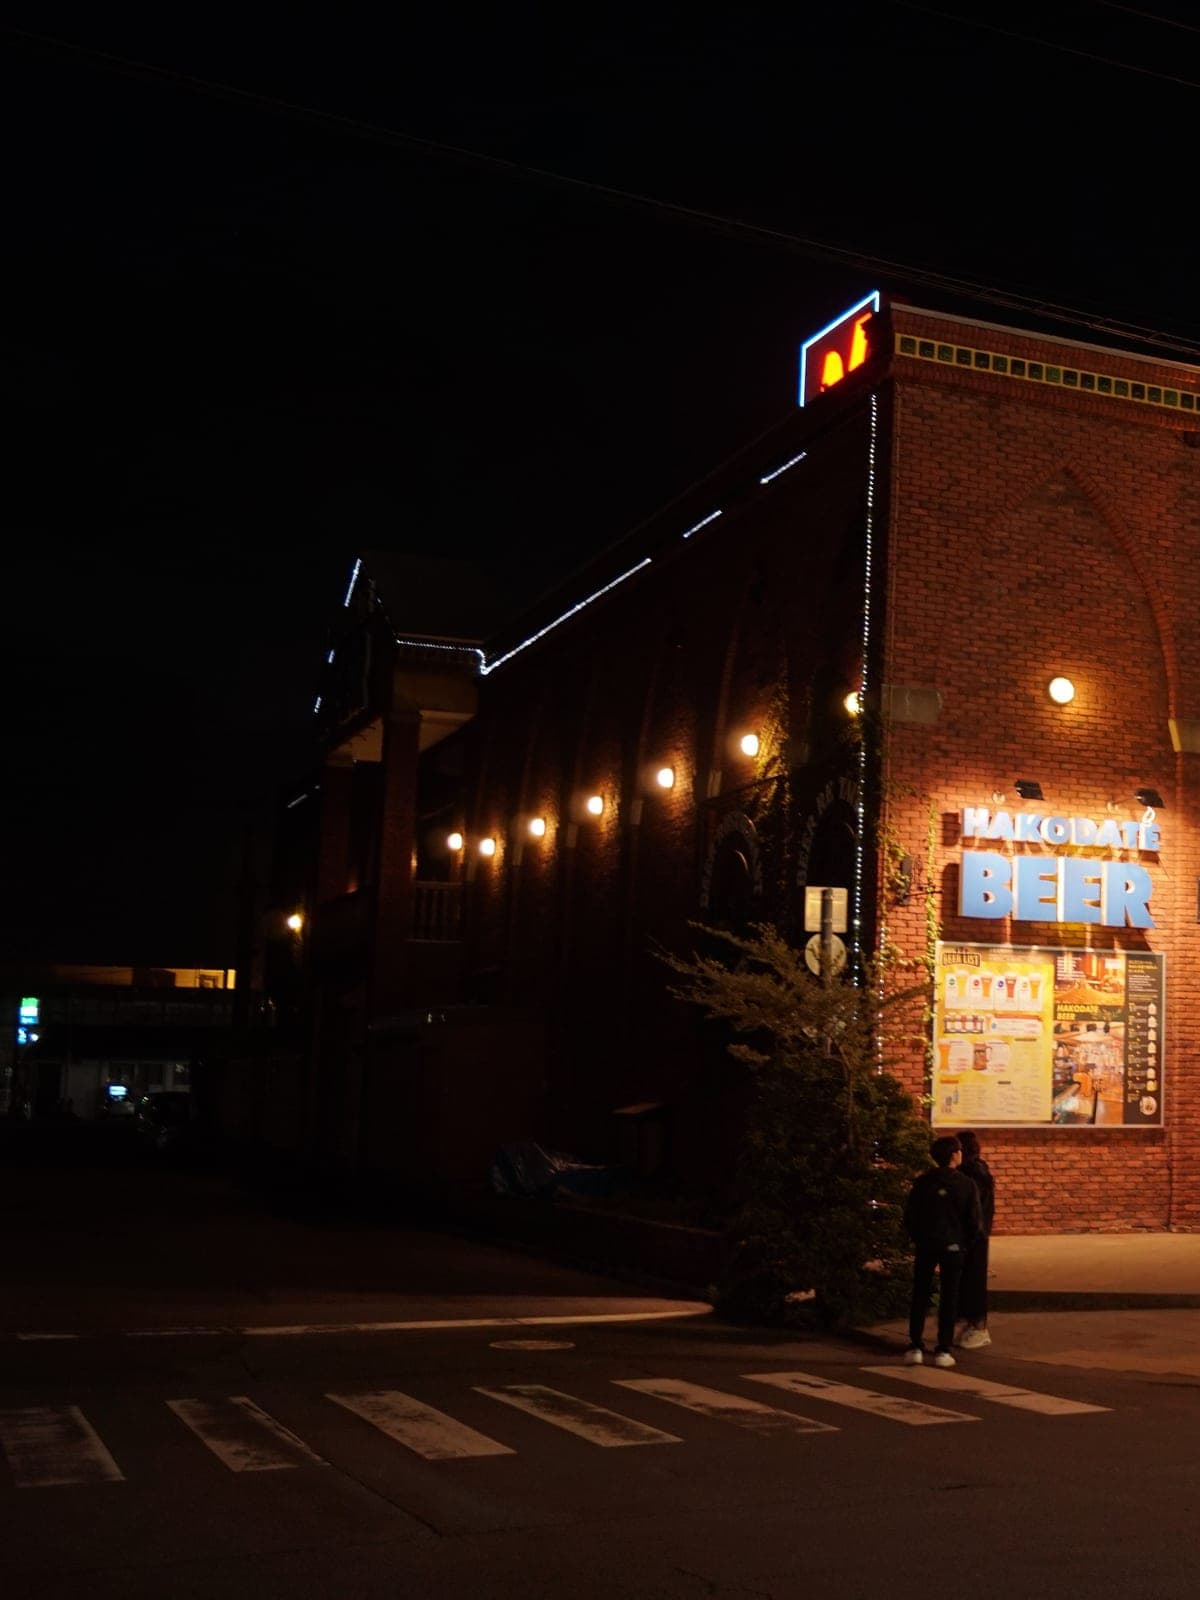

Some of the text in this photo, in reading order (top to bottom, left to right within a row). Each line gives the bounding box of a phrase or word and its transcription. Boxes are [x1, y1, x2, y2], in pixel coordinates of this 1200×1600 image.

[960, 807, 1161, 852] HAKODATE
[958, 851, 1155, 929] BEER
[1056, 1004, 1100, 1014] HAKODATE
